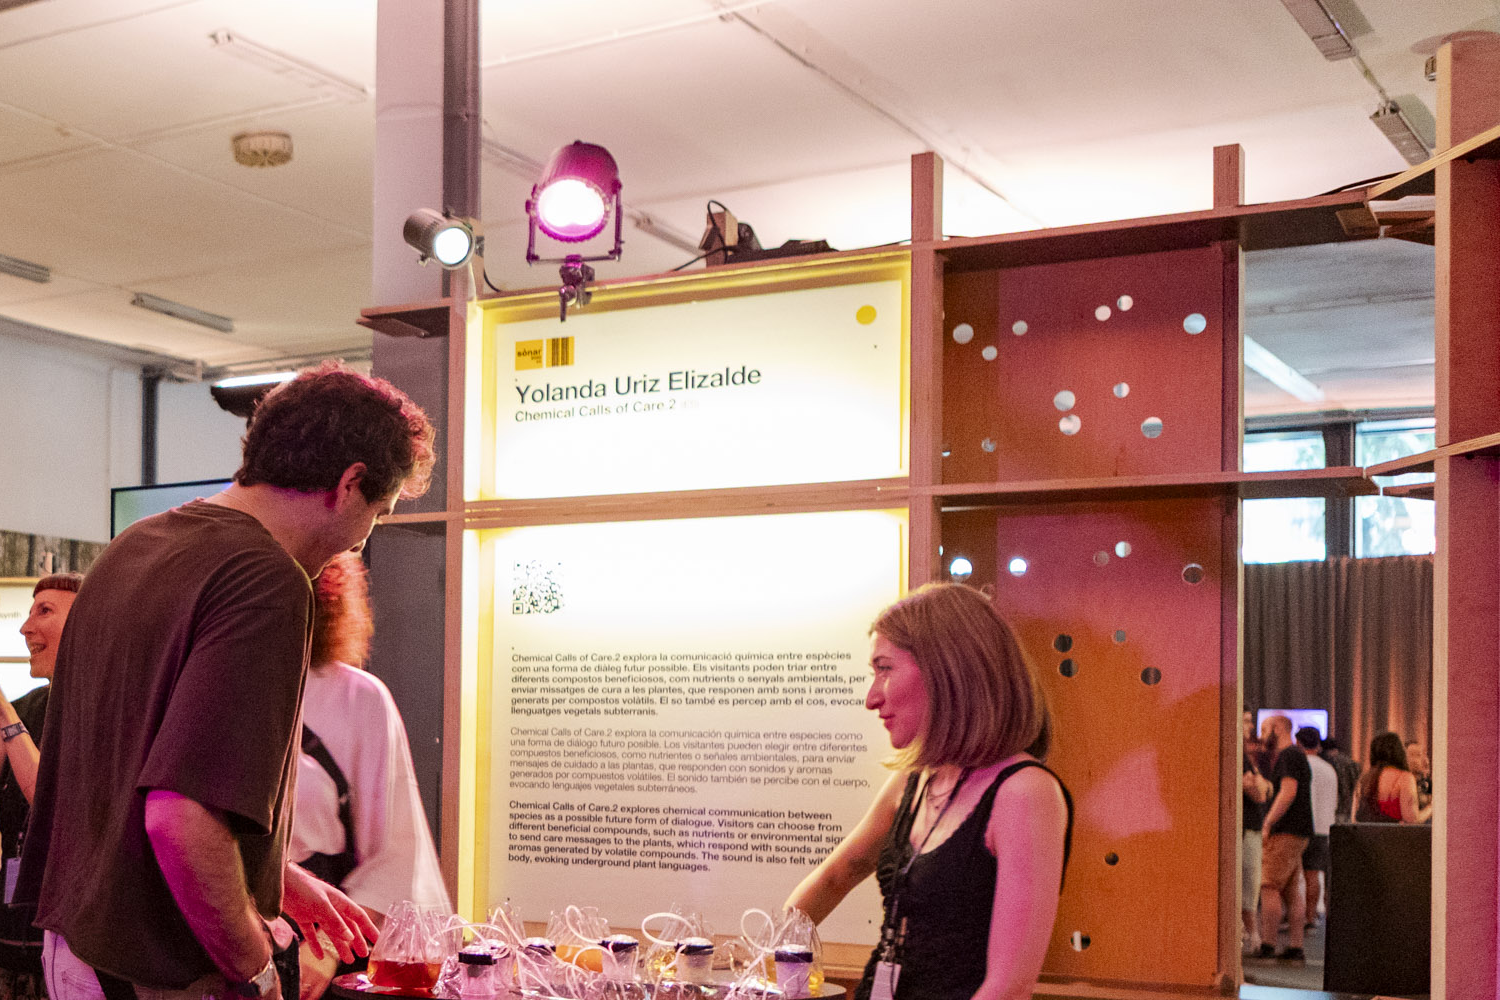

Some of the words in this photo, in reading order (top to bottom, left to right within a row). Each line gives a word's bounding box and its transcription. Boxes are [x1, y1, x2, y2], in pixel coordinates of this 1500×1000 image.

[515, 379, 607, 404] Yolanda
[615, 374, 661, 396] Uriz
[668, 365, 762, 391] Elizalde
[515, 407, 575, 423] Chemical
[579, 404, 611, 418] Calls
[616, 402, 628, 414] of
[511, 653, 553, 662] Chemical
[554, 653, 577, 661] Calls
[579, 653, 588, 661] of
[622, 652, 657, 663] explora
[659, 652, 668, 661] la
[776, 651, 803, 660] entre
[551, 664, 578, 672] forma
[580, 663, 591, 672] de
[623, 663, 645, 672] futur
[692, 663, 707, 672] Els
[709, 663, 750, 672] visitants
[752, 663, 784, 673] poden
[787, 663, 807, 671] triar
[810, 662, 837, 671] entre
[511, 674, 550, 683] diferents
[551, 674, 602, 685] compostos
[692, 674, 735, 683] nutrients
[747, 674, 785, 685] senyals
[849, 676, 866, 685] per
[511, 685, 537, 693] enviar
[539, 685, 585, 696] missatges
[587, 685, 599, 693] de
[632, 685, 646, 694] les
[687, 687, 706, 696] que
[708, 687, 755, 696] responen
[757, 685, 779, 694] amb
[808, 685, 812, 694] i
[510, 695, 549, 706] generats
[551, 697, 566, 706] per
[568, 696, 620, 706] compostos
[659, 696, 668, 704] El
[732, 698, 767, 707] percep
[769, 696, 792, 705] amb
[794, 696, 803, 705] el
[510, 705, 561, 716] llenguatges
[563, 706, 601, 717] vegetals
[509, 800, 550, 810] Chemical
[552, 802, 575, 811] Calls
[576, 803, 586, 811] of
[588, 803, 618, 812] Care.2
[620, 805, 660, 815] explores
[662, 806, 706, 815] chemical
[708, 809, 785, 818] communication
[787, 810, 832, 820] between
[509, 812, 543, 822] species
[565, 814, 603, 824] possible
[605, 814, 632, 824] future
[634, 816, 657, 825] form
[659, 817, 669, 825] of
[717, 818, 754, 828] Visitors
[777, 821, 815, 830] choose
[817, 822, 842, 831] from
[508, 821, 545, 831] different
[547, 823, 591, 833] beneficial
[652, 828, 676, 836] such
[691, 829, 735, 838] nutrients
[750, 831, 822, 842] environmental
[508, 831, 518, 840] to
[519, 832, 541, 841] send
[565, 836, 612, 846] messages
[613, 836, 623, 844] to
[625, 836, 640, 845] the
[676, 839, 705, 848] which
[707, 841, 748, 851] respond
[750, 842, 772, 851] with
[774, 844, 812, 853] sounds
[534, 855, 569, 866] evoking
[571, 856, 630, 868] underground
[632, 859, 656, 869] plant
[543, 846, 589, 855] generated
[591, 846, 603, 857] by
[604, 847, 637, 856] volatile
[701, 851, 719, 860] The
[722, 853, 753, 861] sound
[755, 853, 764, 862] is
[766, 854, 787, 863] also
[789, 855, 805, 864] felt
